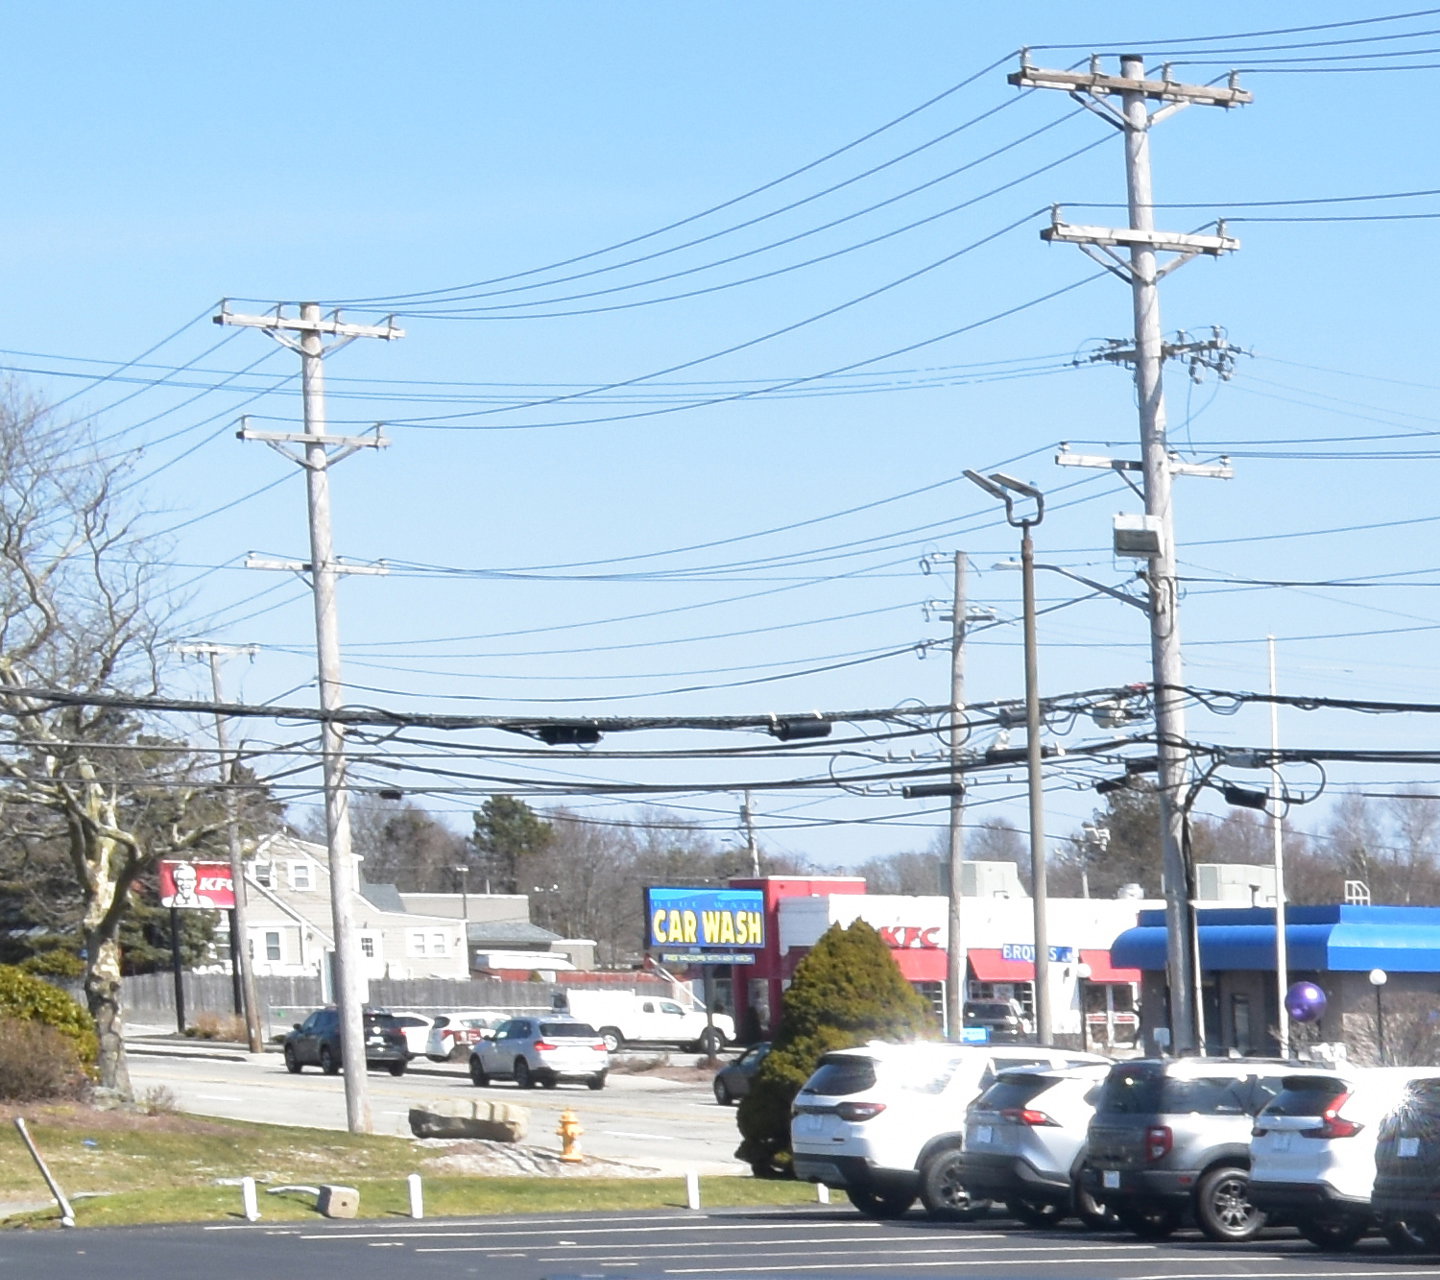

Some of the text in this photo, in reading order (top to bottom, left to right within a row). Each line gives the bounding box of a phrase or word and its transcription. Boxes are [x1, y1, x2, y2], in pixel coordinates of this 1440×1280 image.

[653, 909, 762, 945] CAR WASH
[880, 926, 941, 949] KFC
